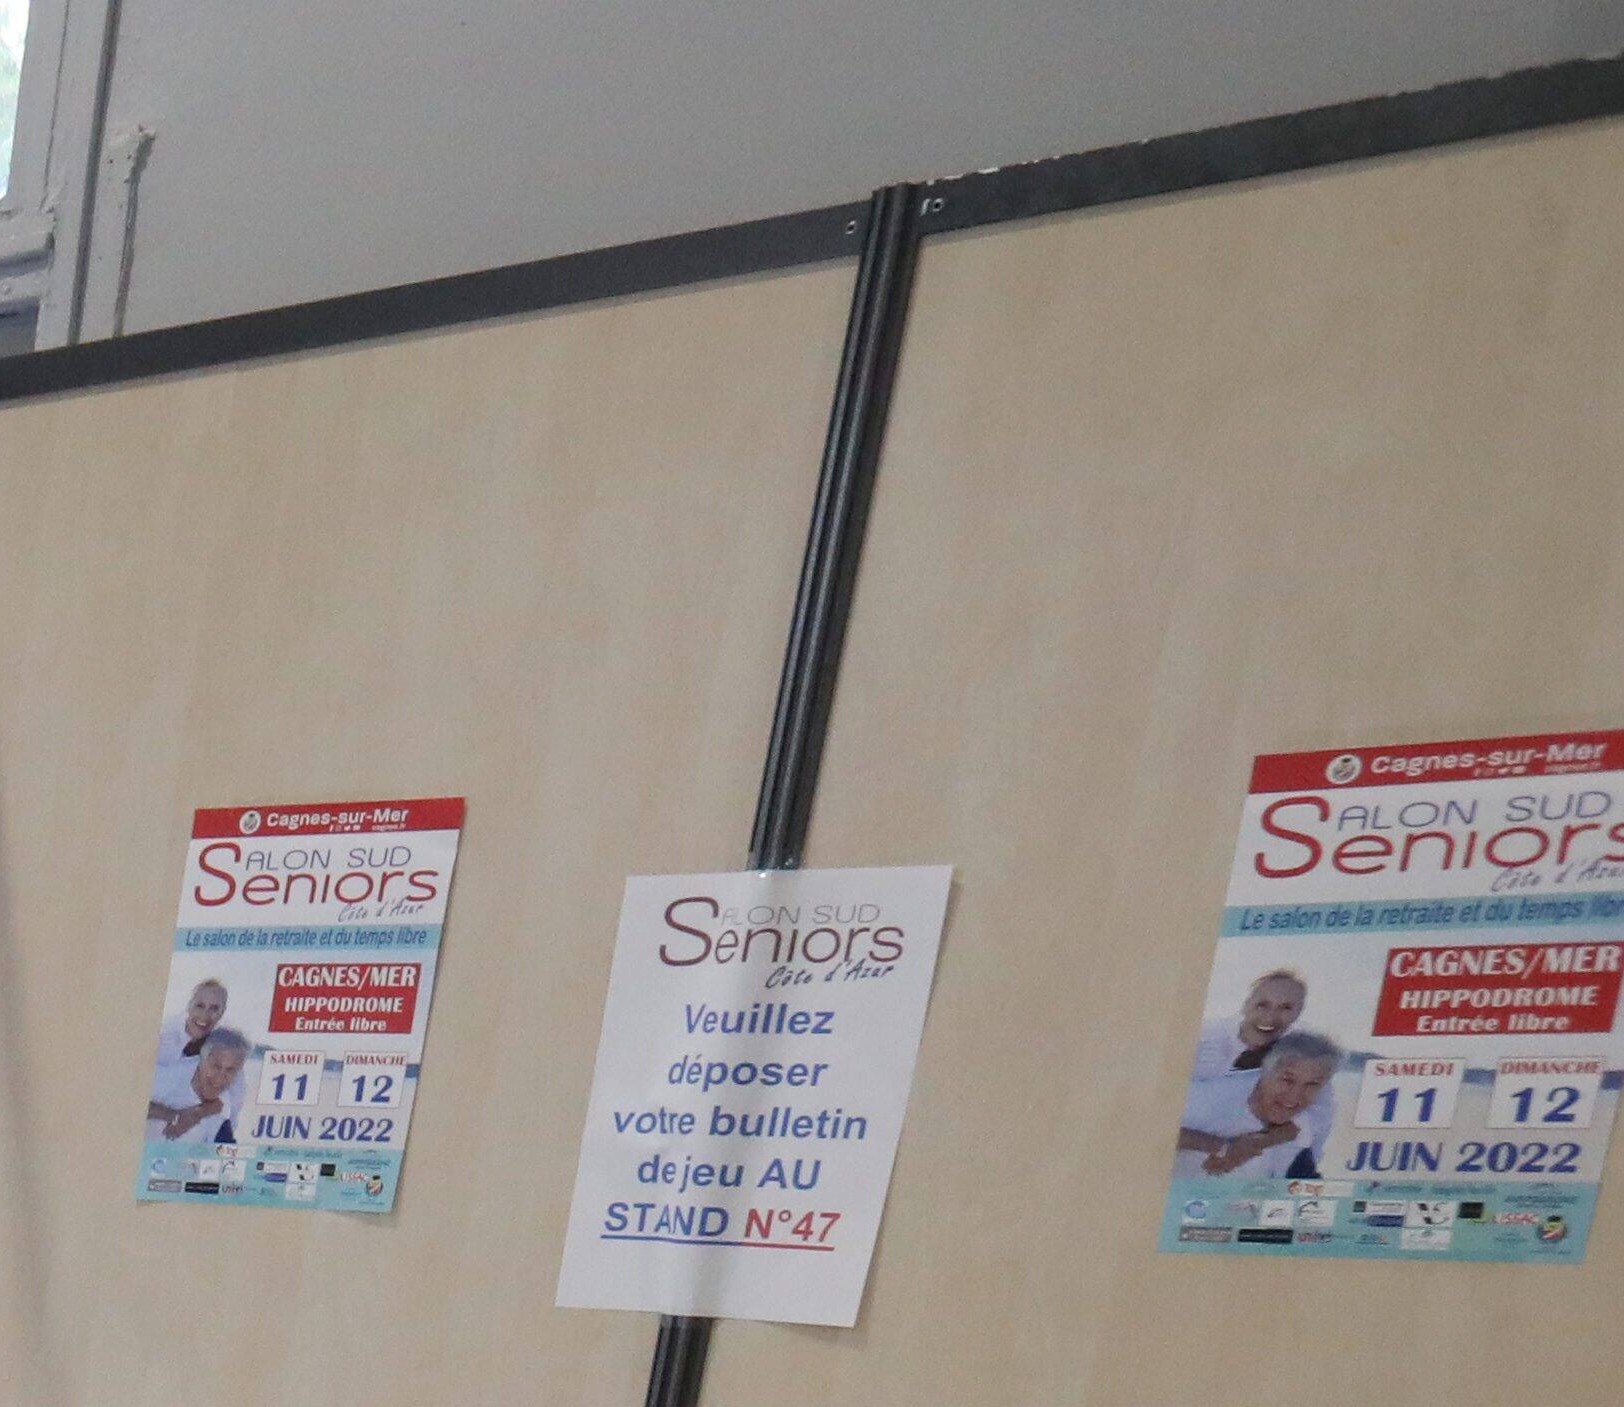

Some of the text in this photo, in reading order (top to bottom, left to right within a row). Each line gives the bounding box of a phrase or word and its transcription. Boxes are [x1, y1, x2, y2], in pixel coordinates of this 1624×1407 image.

[1369, 741, 1608, 776] Cagnes-sur-Mer
[266, 806, 410, 828] Cagnes-sur-Mer
[1504, 790, 1611, 823] SUD
[346, 845, 412, 869] SUD
[193, 841, 440, 907] Seniors
[812, 903, 882, 925] SUD
[1267, 898, 1581, 930] salon la retraite temps
[185, 927, 428, 951] Le salon de la retraite et du temps libre
[658, 896, 905, 968] Seniors
[277, 965, 417, 989] CAGNES/MER
[1389, 945, 1623, 978] CAGNES/MER
[283, 995, 403, 1014] HIPPODROME
[1398, 986, 1600, 1010] HIPPODROME
[294, 1016, 387, 1032] Entrée libre
[684, 1002, 836, 1036] Veuillez
[1415, 1012, 1570, 1033] Entrée libre
[269, 1053, 408, 1066] SAMEDI DIMANCHE
[667, 1054, 830, 1094] déposer
[1373, 1060, 1601, 1077] SAMEDI DIMANCHE
[270, 1073, 394, 1103] 11 12
[1376, 1085, 1578, 1124] 11 12
[251, 1114, 393, 1143] JUIN 2022
[613, 1105, 869, 1141] votre bulletin
[1345, 1140, 1582, 1174] JUIN 2022
[757, 1159, 822, 1191] AU
[603, 1201, 843, 1243] STAND N°47
